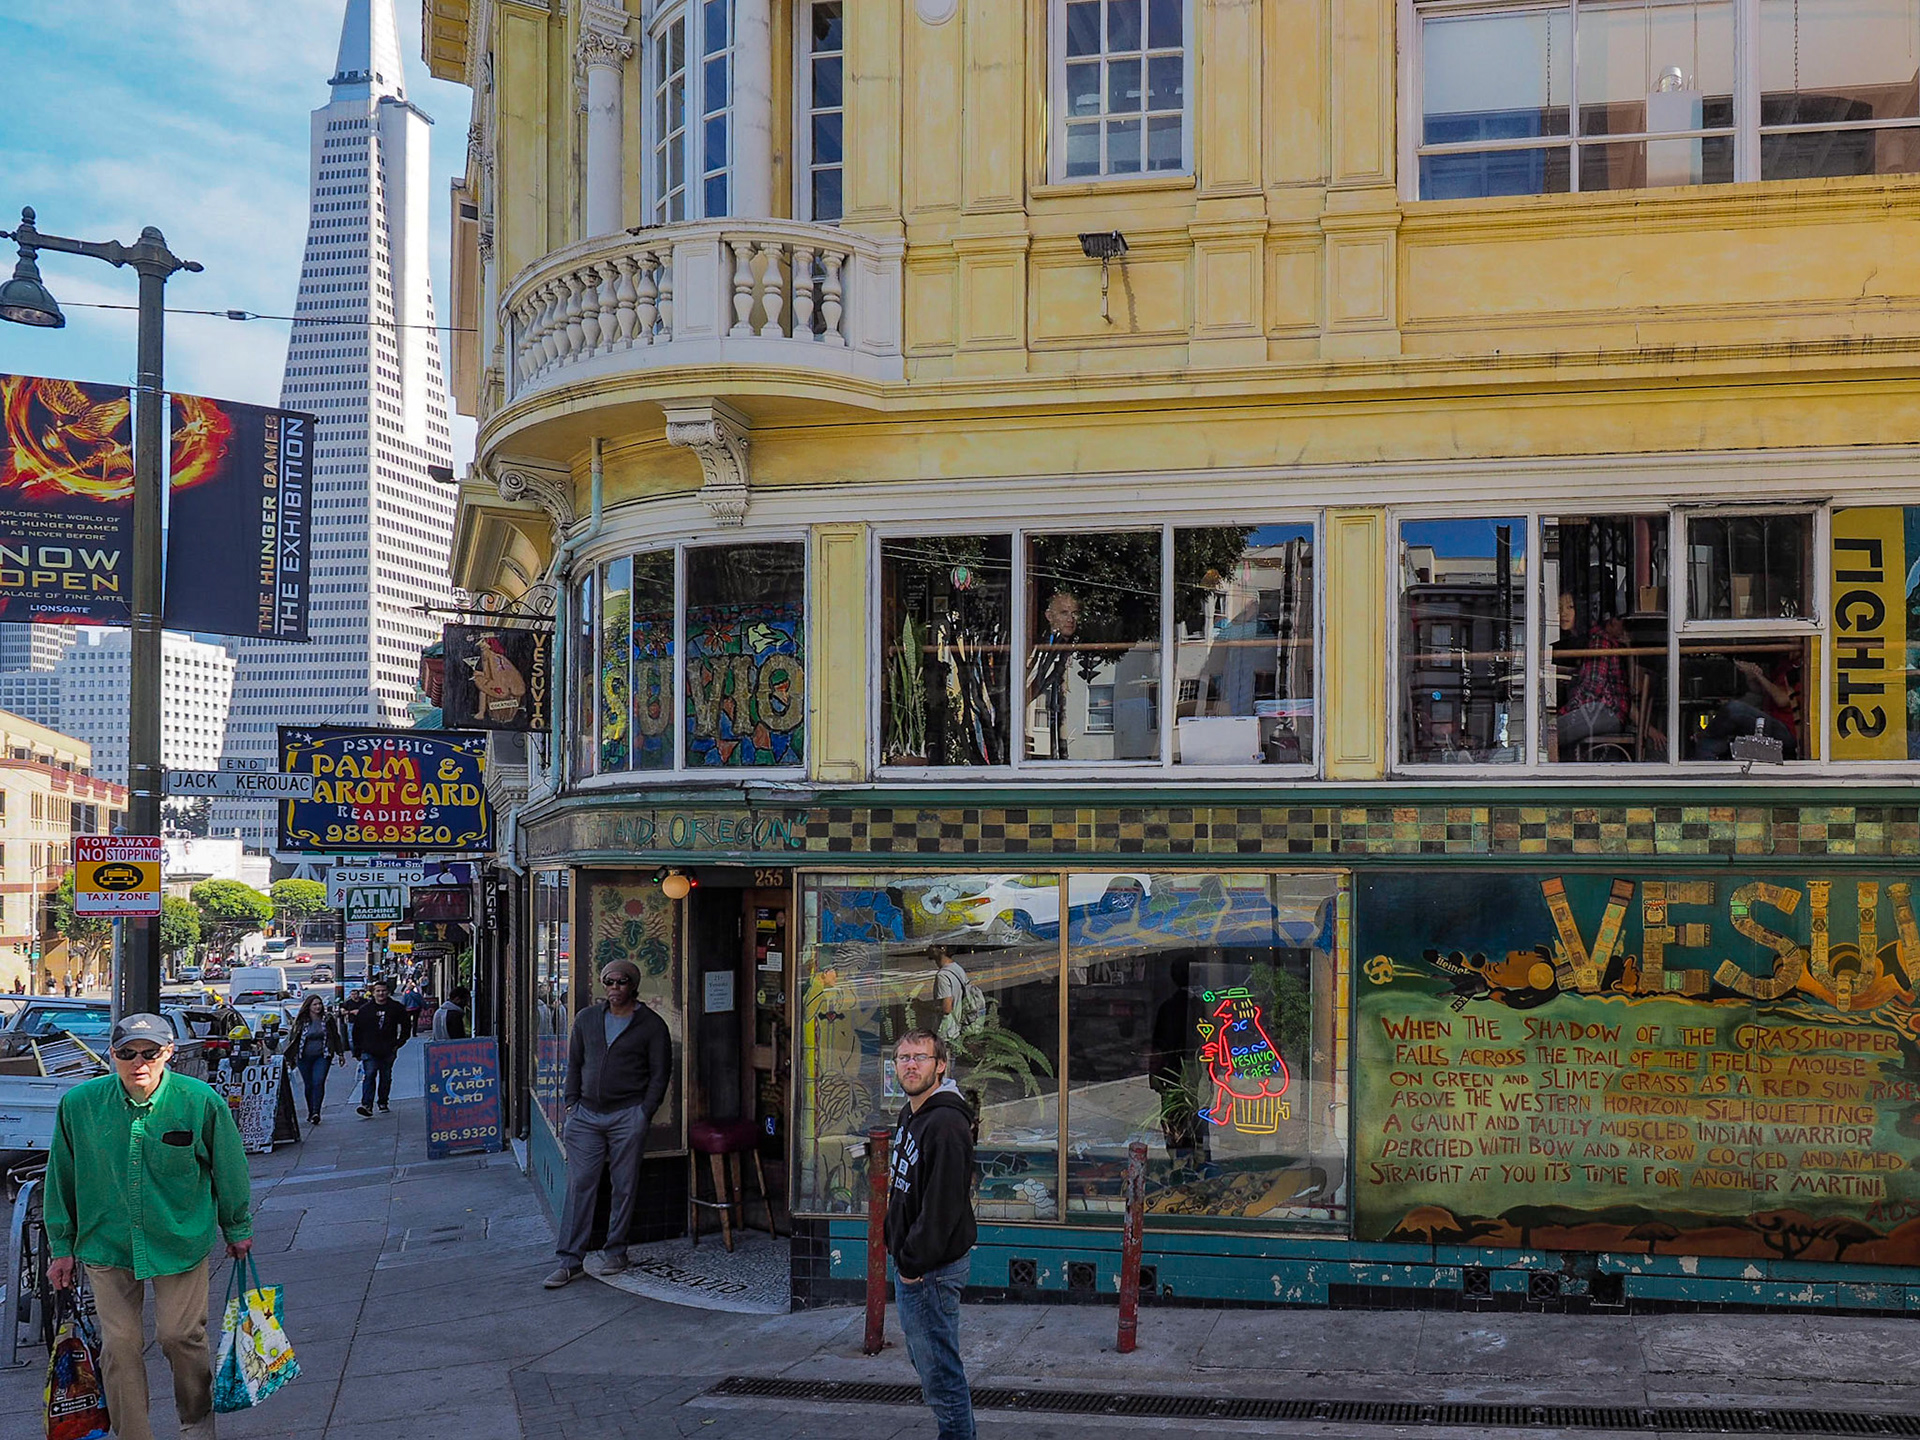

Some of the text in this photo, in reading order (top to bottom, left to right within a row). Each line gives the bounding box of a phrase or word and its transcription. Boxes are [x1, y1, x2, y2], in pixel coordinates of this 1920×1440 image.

[0, 510, 40, 518] XPLORE
[259, 414, 279, 633] THE HUNGER GAMES
[22, 521, 73, 530] HUNGER
[77, 524, 119, 532] GAMES
[280, 417, 304, 635] THE EXHIBITION
[0, 544, 120, 571] NOW
[0, 569, 119, 592] OPEN
[30, 604, 91, 614] LIONSGATE
[530, 632, 547, 729] VESUVIO
[343, 738, 434, 756] PSYCHIC
[227, 760, 258, 769] END
[311, 754, 463, 781] PALM &
[173, 773, 309, 791] JACK KEROUAC
[300, 780, 480, 807] AROT CARD
[337, 805, 440, 822] READINGS
[82, 838, 154, 847] TOW-AWAY
[325, 824, 452, 843] 986.9320
[79, 848, 159, 861] NO STOPPING
[336, 872, 425, 882] SUSIE HO
[755, 868, 784, 887] 255
[86, 893, 151, 901] TAXI ZONE
[349, 888, 400, 908] ATM
[1382, 1015, 1900, 1051] WHEN THE SHADOW OF THE GRASSHOPPER
[1231, 1049, 1276, 1069] VESUVIO
[1396, 1045, 1449, 1066] FALLS
[1459, 1048, 1526, 1068] ACROSS
[1536, 1046, 1567, 1064] THE
[1573, 1047, 1624, 1068] TRAIL
[1630, 1052, 1652, 1069] OF
[1664, 1052, 1698, 1070] THE
[1788, 1058, 1866, 1076] MOUSE
[441, 1066, 486, 1079] PALM
[430, 1078, 495, 1094] & TAROT
[1390, 1071, 1422, 1087] ON
[1433, 1071, 1493, 1087] GREEN
[1503, 1075, 1529, 1085] AND
[1621, 1073, 1688, 1093] GRASS
[1700, 1076, 1726, 1092] AS
[1737, 1076, 1751, 1093] A
[1763, 1080, 1809, 1097] RED
[1823, 1081, 1860, 1099] SUN
[442, 1092, 483, 1105] CARD
[1391, 1090, 1455, 1108] ABOVE
[1464, 1088, 1492, 1107] THE
[1499, 1092, 1590, 1113] WESTERN
[1605, 1095, 1688, 1116] HORIZON
[430, 1125, 498, 1143] 986.9320
[1383, 1114, 1403, 1133] A
[1411, 1113, 1477, 1132] GAUNT
[1485, 1115, 1520, 1131] AND
[1527, 1116, 1592, 1137] TAUTLY
[1600, 1120, 1688, 1140] MUSCLED
[1382, 1139, 1473, 1159] PERCHED
[1479, 1136, 1520, 1156] WITH
[1529, 1138, 1574, 1158] BOW
[1583, 1143, 1619, 1159] AND
[1627, 1143, 1695, 1161] ARROW
[1707, 1150, 1787, 1170] COCKED
[1801, 1151, 1837, 1168] AND
[1469, 1167, 1491, 1182] AT
[1500, 1167, 1536, 1184] YOU
[1644, 1167, 1679, 1188] FOR
[1692, 1171, 1778, 1191] ANOTHER
